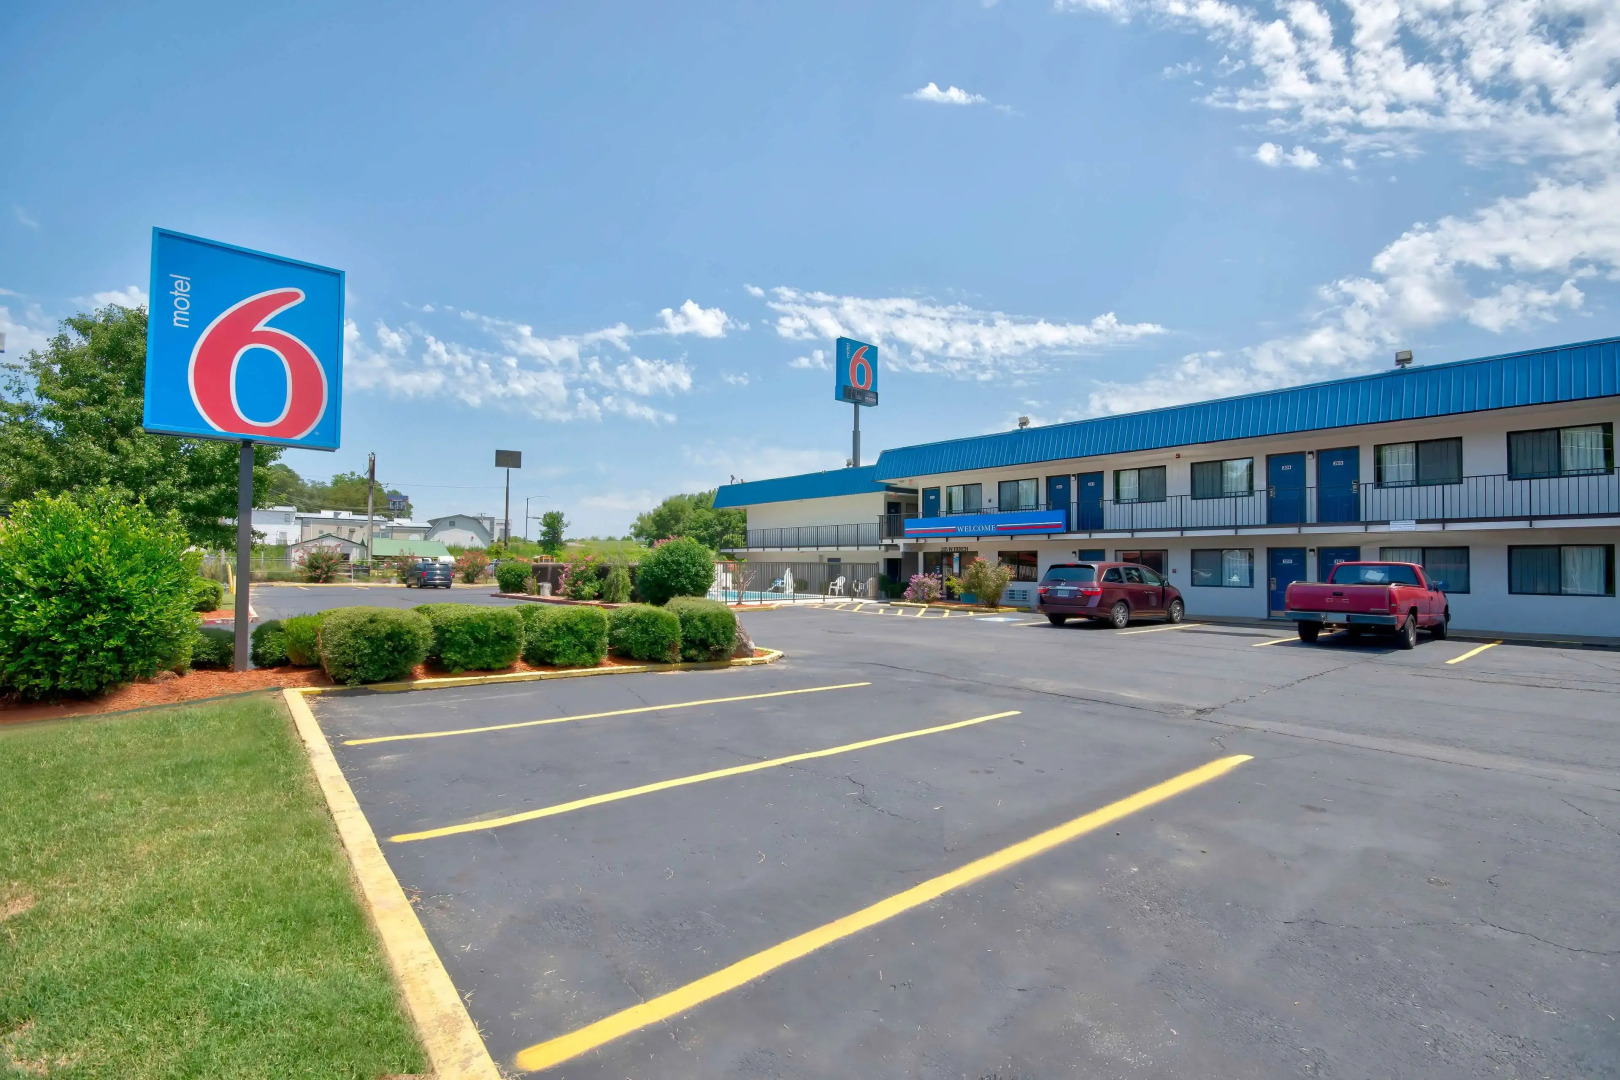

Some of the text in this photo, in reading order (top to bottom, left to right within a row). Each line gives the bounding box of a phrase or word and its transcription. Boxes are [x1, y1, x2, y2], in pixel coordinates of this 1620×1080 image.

[169, 273, 191, 328] motel
[187, 287, 328, 440] 6
[850, 346, 872, 390] 6
[957, 524, 996, 533] WELCOME
